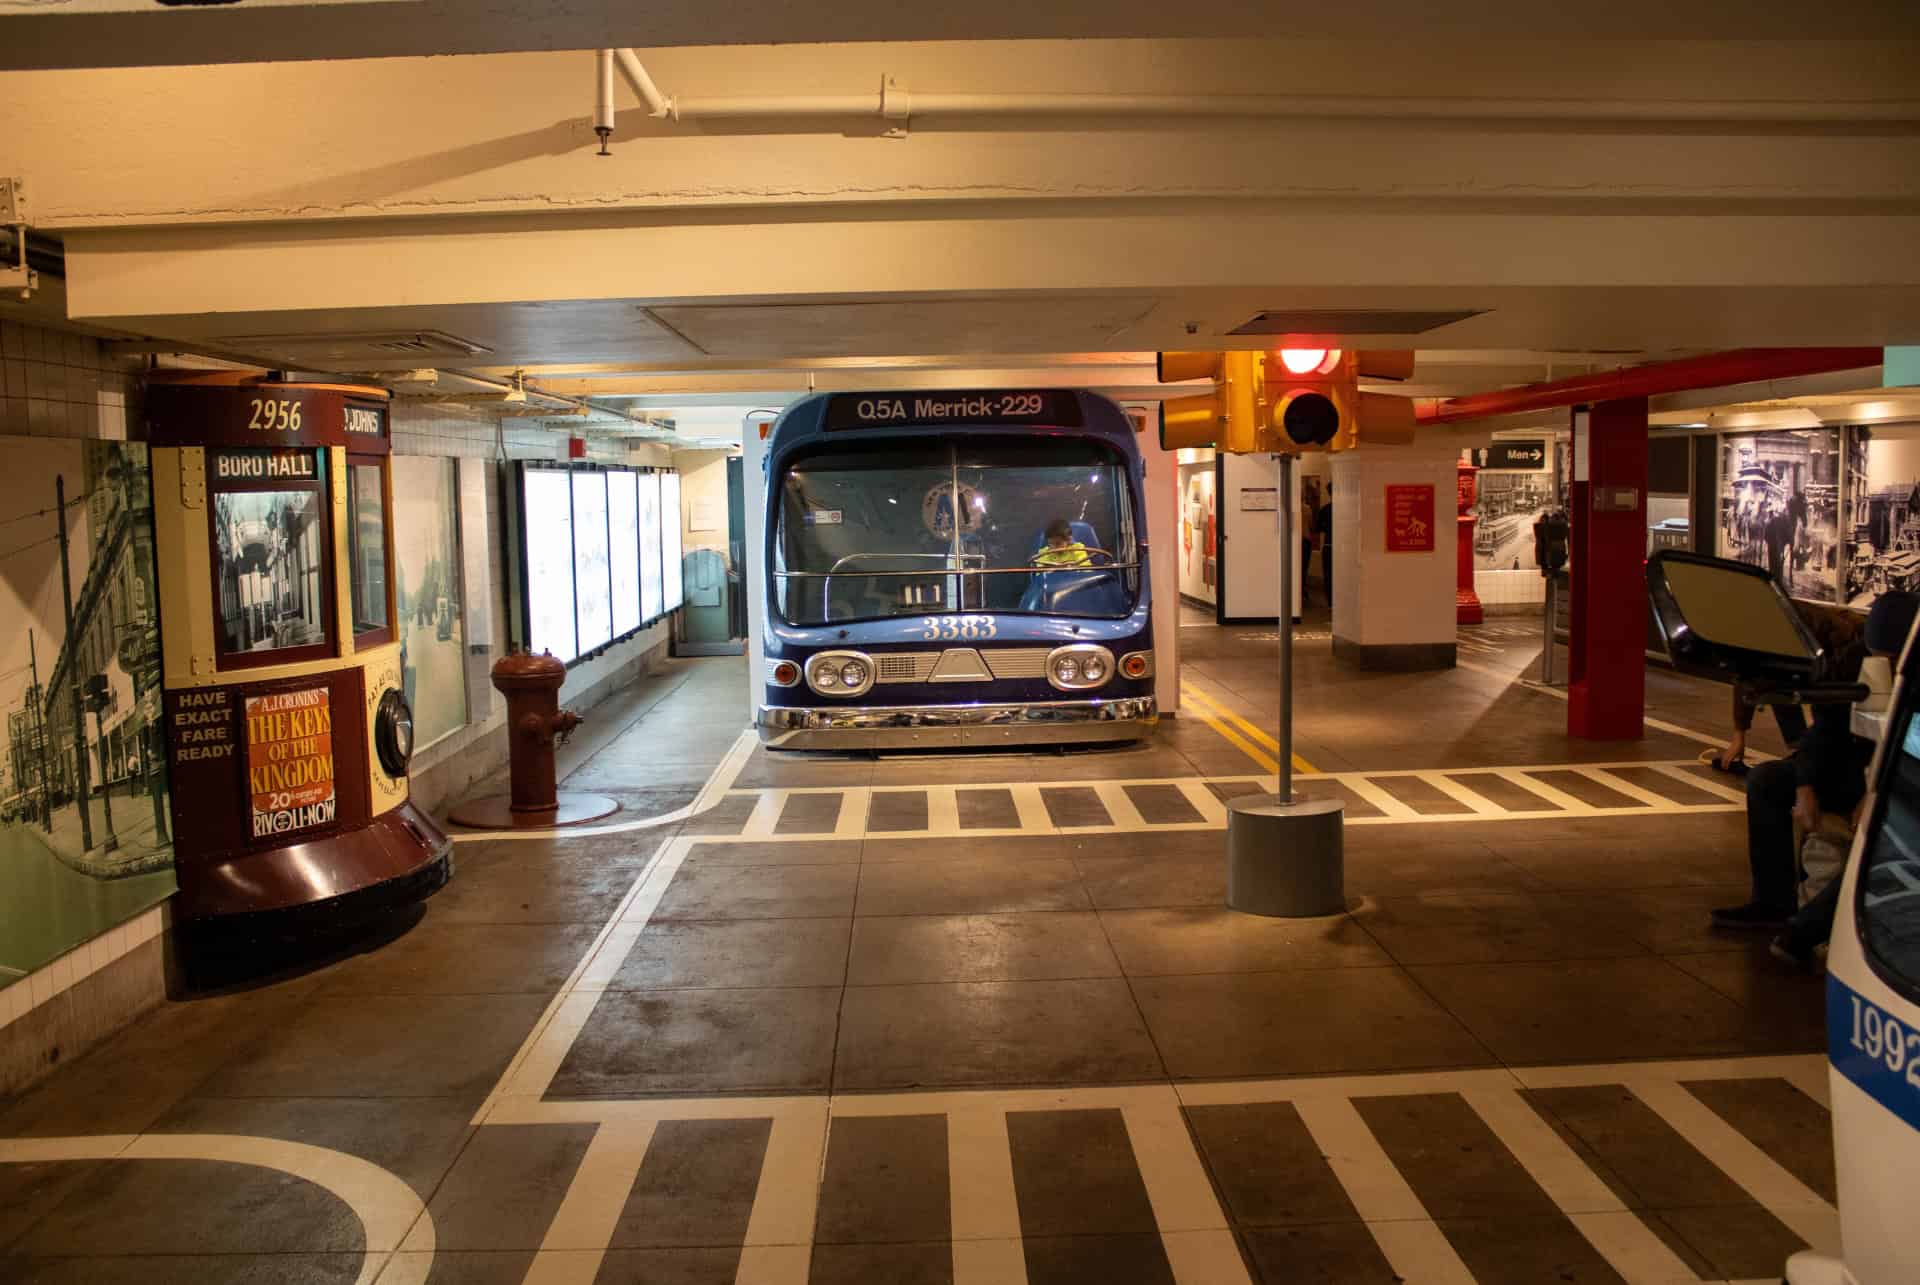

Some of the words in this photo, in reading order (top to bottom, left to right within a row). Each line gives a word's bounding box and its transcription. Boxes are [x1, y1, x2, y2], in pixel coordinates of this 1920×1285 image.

[248, 399, 302, 430] 2956
[857, 399, 907, 419] Q5A
[218, 455, 263, 477] BORO
[267, 454, 312, 476] HALL
[1507, 449, 1529, 460] Men
[923, 615, 997, 640] 3383
[179, 691, 226, 707] HAVE
[176, 708, 232, 726] EXACT
[249, 714, 288, 744] THE
[290, 706, 331, 738] KEYS
[182, 727, 226, 743] FARE
[177, 744, 234, 762] READY
[268, 743, 288, 761] OF
[289, 737, 320, 757] THE
[252, 755, 333, 793] KINGDOM
[1850, 996, 1920, 1090] 1992
